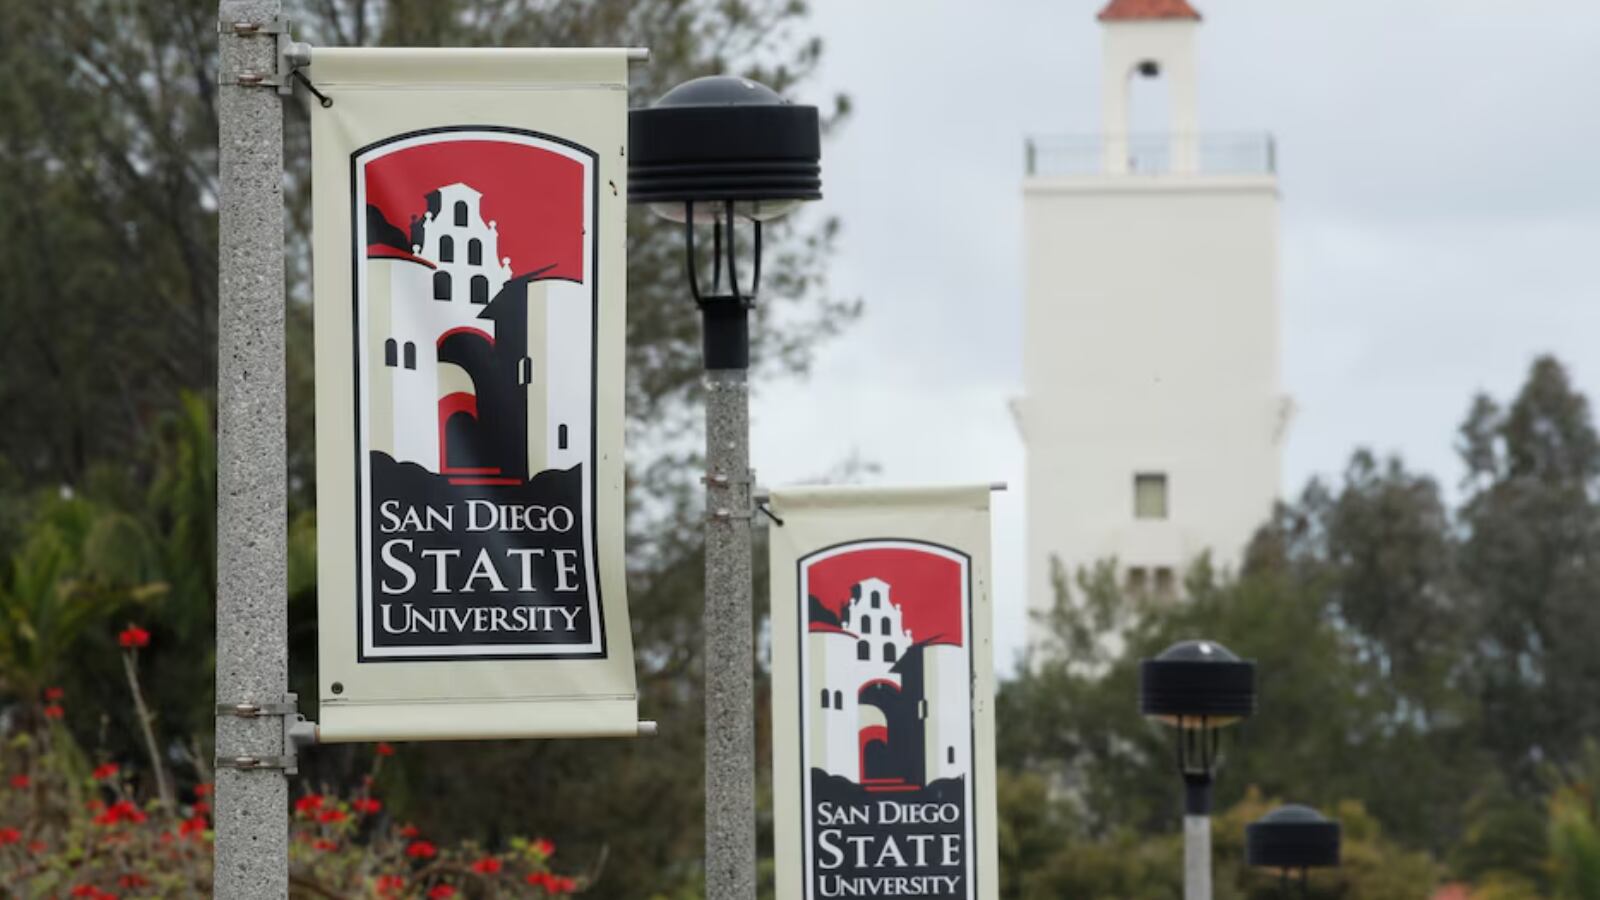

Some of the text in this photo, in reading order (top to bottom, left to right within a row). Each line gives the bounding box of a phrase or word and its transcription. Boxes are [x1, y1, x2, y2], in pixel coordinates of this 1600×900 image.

[380, 499, 574, 532] SAN DIEGO
[380, 538, 580, 594] STATE
[380, 603, 582, 634] UNIVERSITY
[817, 800, 960, 826] SAN DIEGO
[818, 828, 961, 869] STATE
[818, 874, 961, 897] UNIVERSITY
